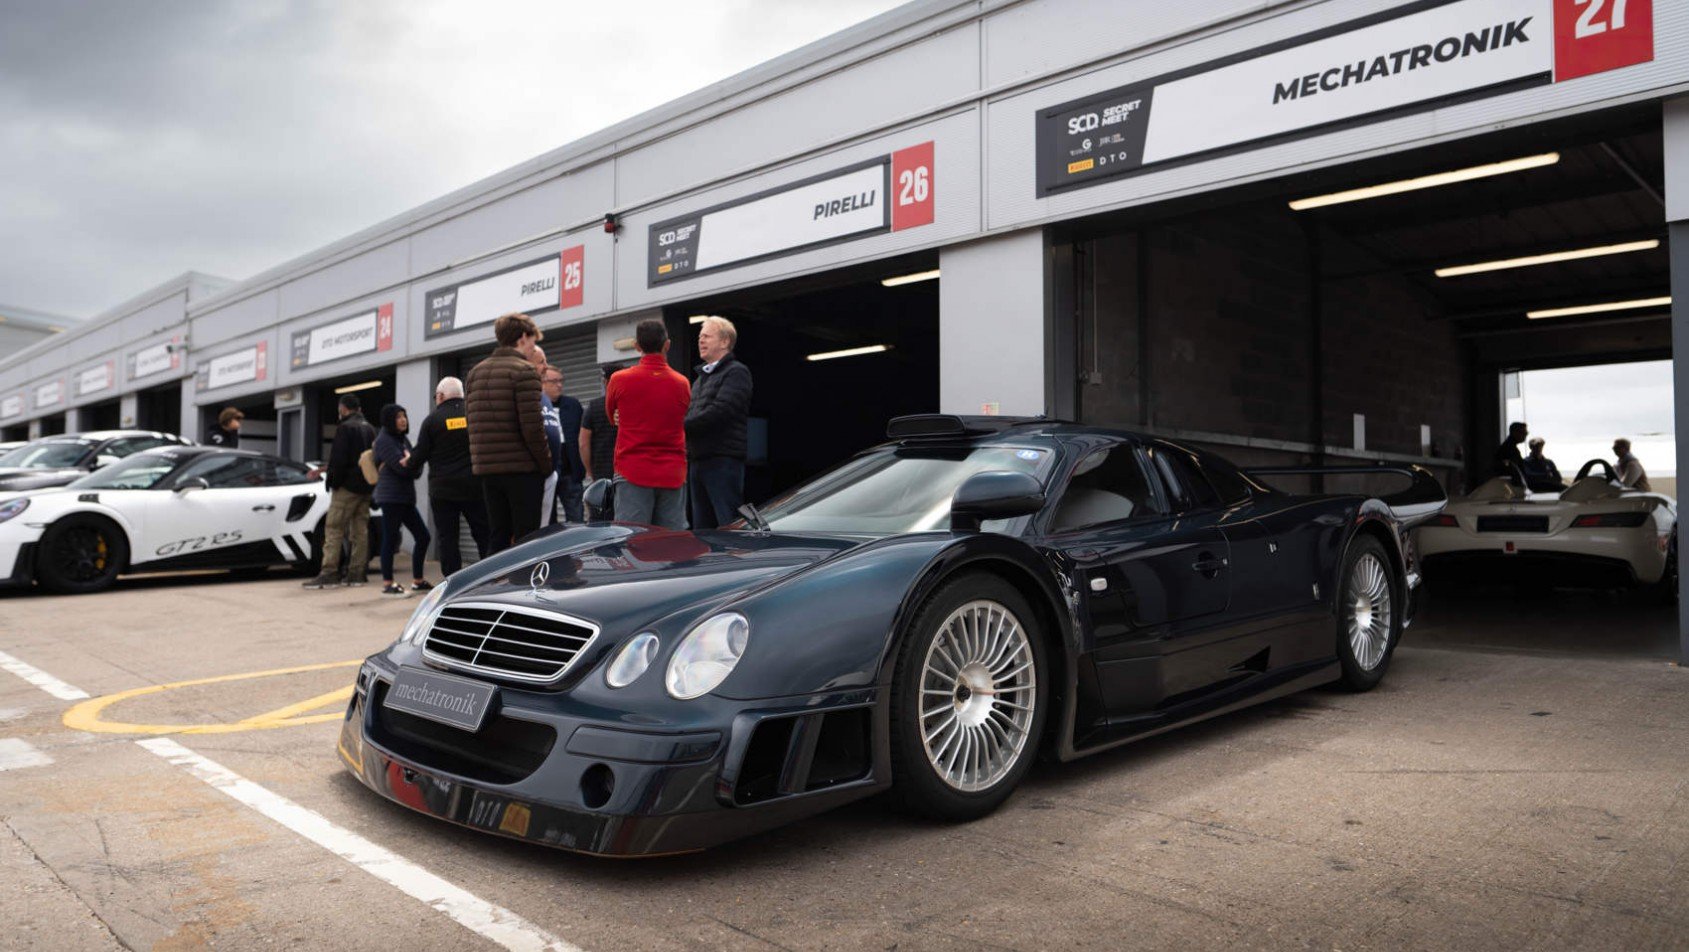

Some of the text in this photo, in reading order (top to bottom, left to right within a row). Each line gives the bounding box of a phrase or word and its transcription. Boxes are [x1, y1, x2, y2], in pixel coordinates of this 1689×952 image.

[1272, 16, 1534, 104] MECHATRONIK
[1102, 112, 1129, 127] MEET
[1103, 99, 1141, 117] SECRET
[1068, 112, 1099, 135] SCD
[899, 165, 929, 206] 26
[813, 189, 876, 221] PIRELLI
[521, 276, 555, 297] PIRELLI
[564, 260, 581, 291] 25
[155, 529, 243, 556] GT2 RS
[395, 681, 478, 716] mechatronik
